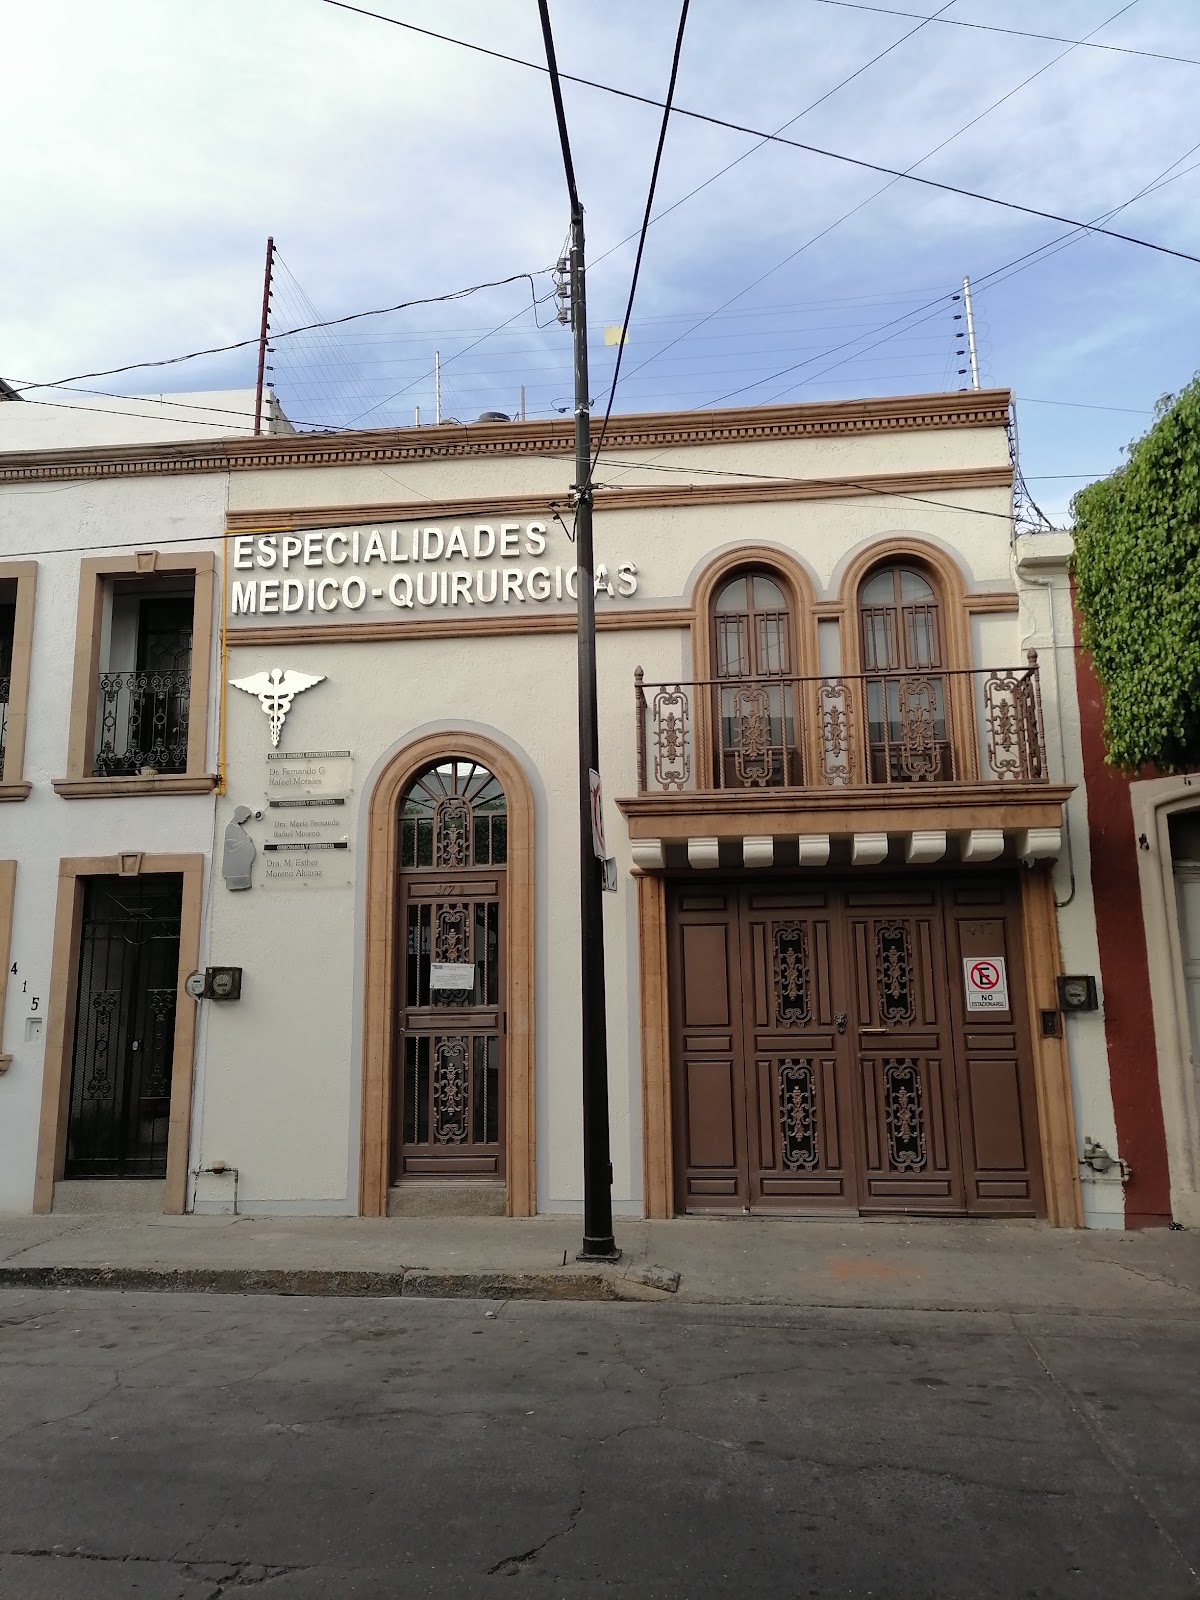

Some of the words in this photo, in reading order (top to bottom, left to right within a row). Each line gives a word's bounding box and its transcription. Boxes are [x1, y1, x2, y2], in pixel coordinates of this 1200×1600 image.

[233, 522, 547, 569] ESPECIALIDADES
[269, 768, 280, 776] Dr.
[282, 767, 317, 775] Fernando
[268, 778, 291, 786] Rafael
[310, 819, 340, 827] Fernanda
[273, 830, 293, 838] Rafael
[266, 859, 282, 867] Dra.
[295, 858, 319, 867] Esther
[265, 870, 294, 878] Moreno
[295, 869, 323, 877] Alcaraz
